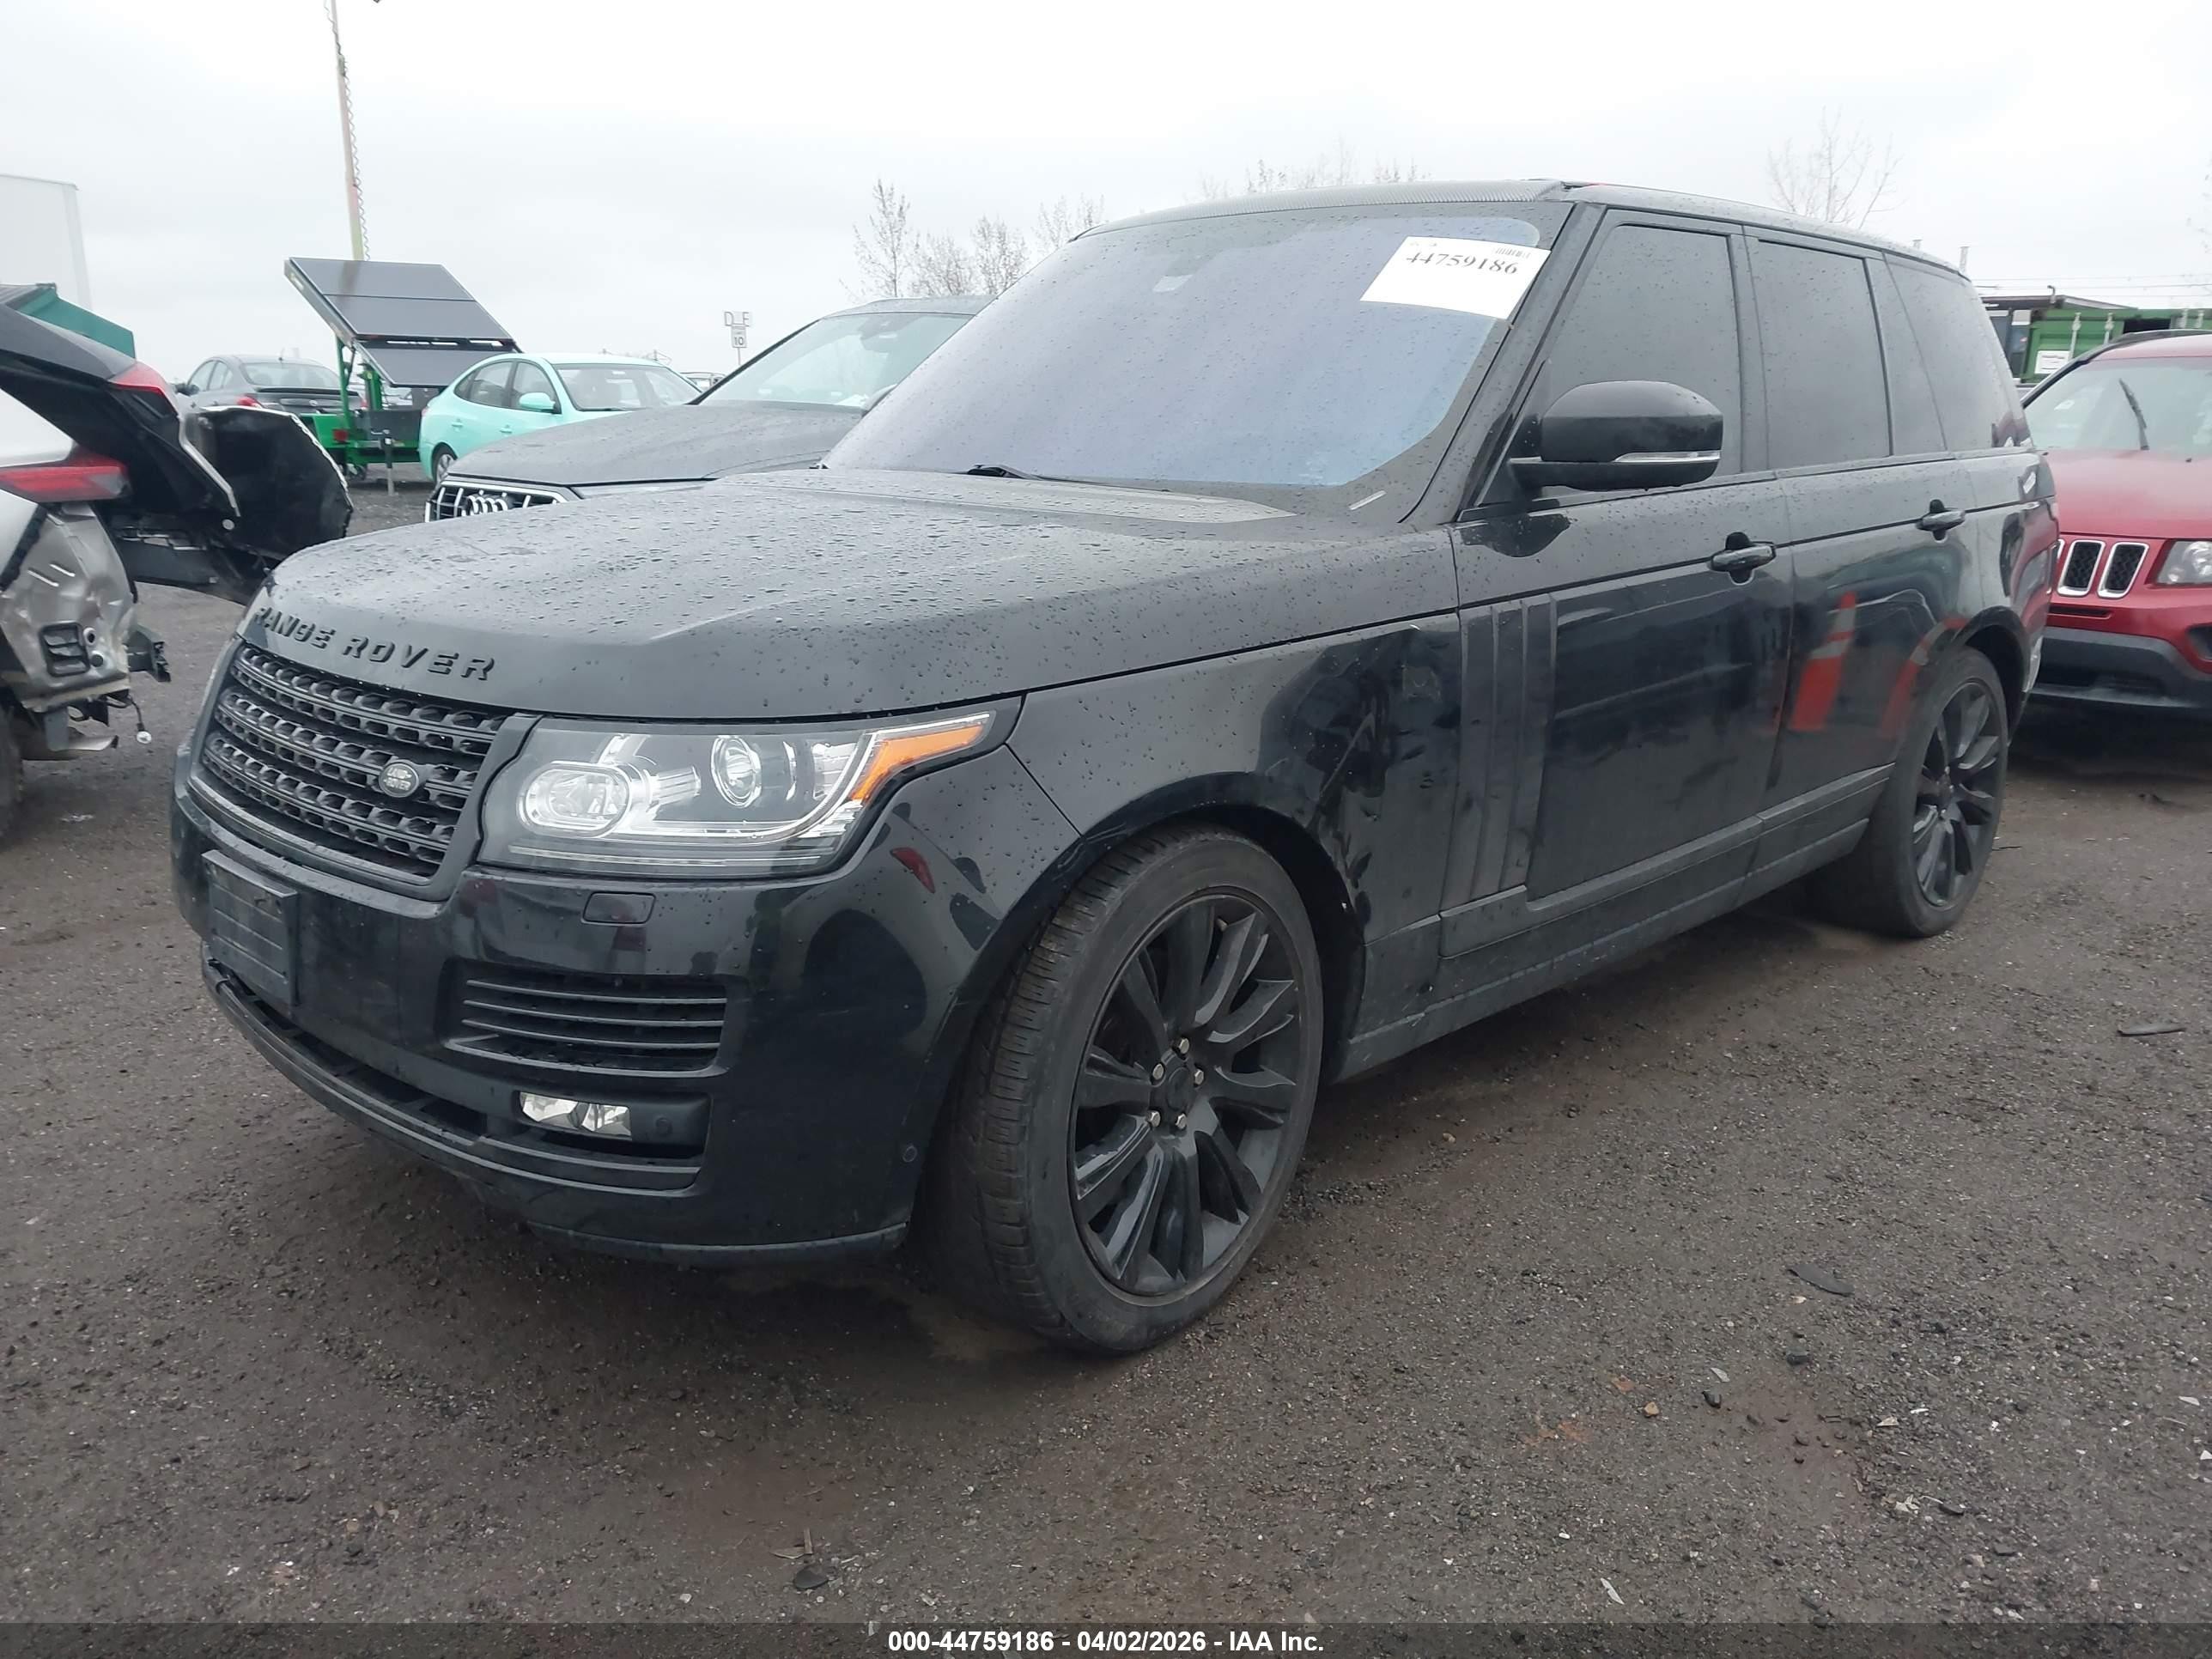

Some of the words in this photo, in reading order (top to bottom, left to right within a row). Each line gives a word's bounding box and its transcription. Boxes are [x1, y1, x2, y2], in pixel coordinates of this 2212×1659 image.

[1406, 252, 1519, 274] 44759186
[253, 606, 337, 649] RANGE
[341, 635, 495, 681] ROVER
